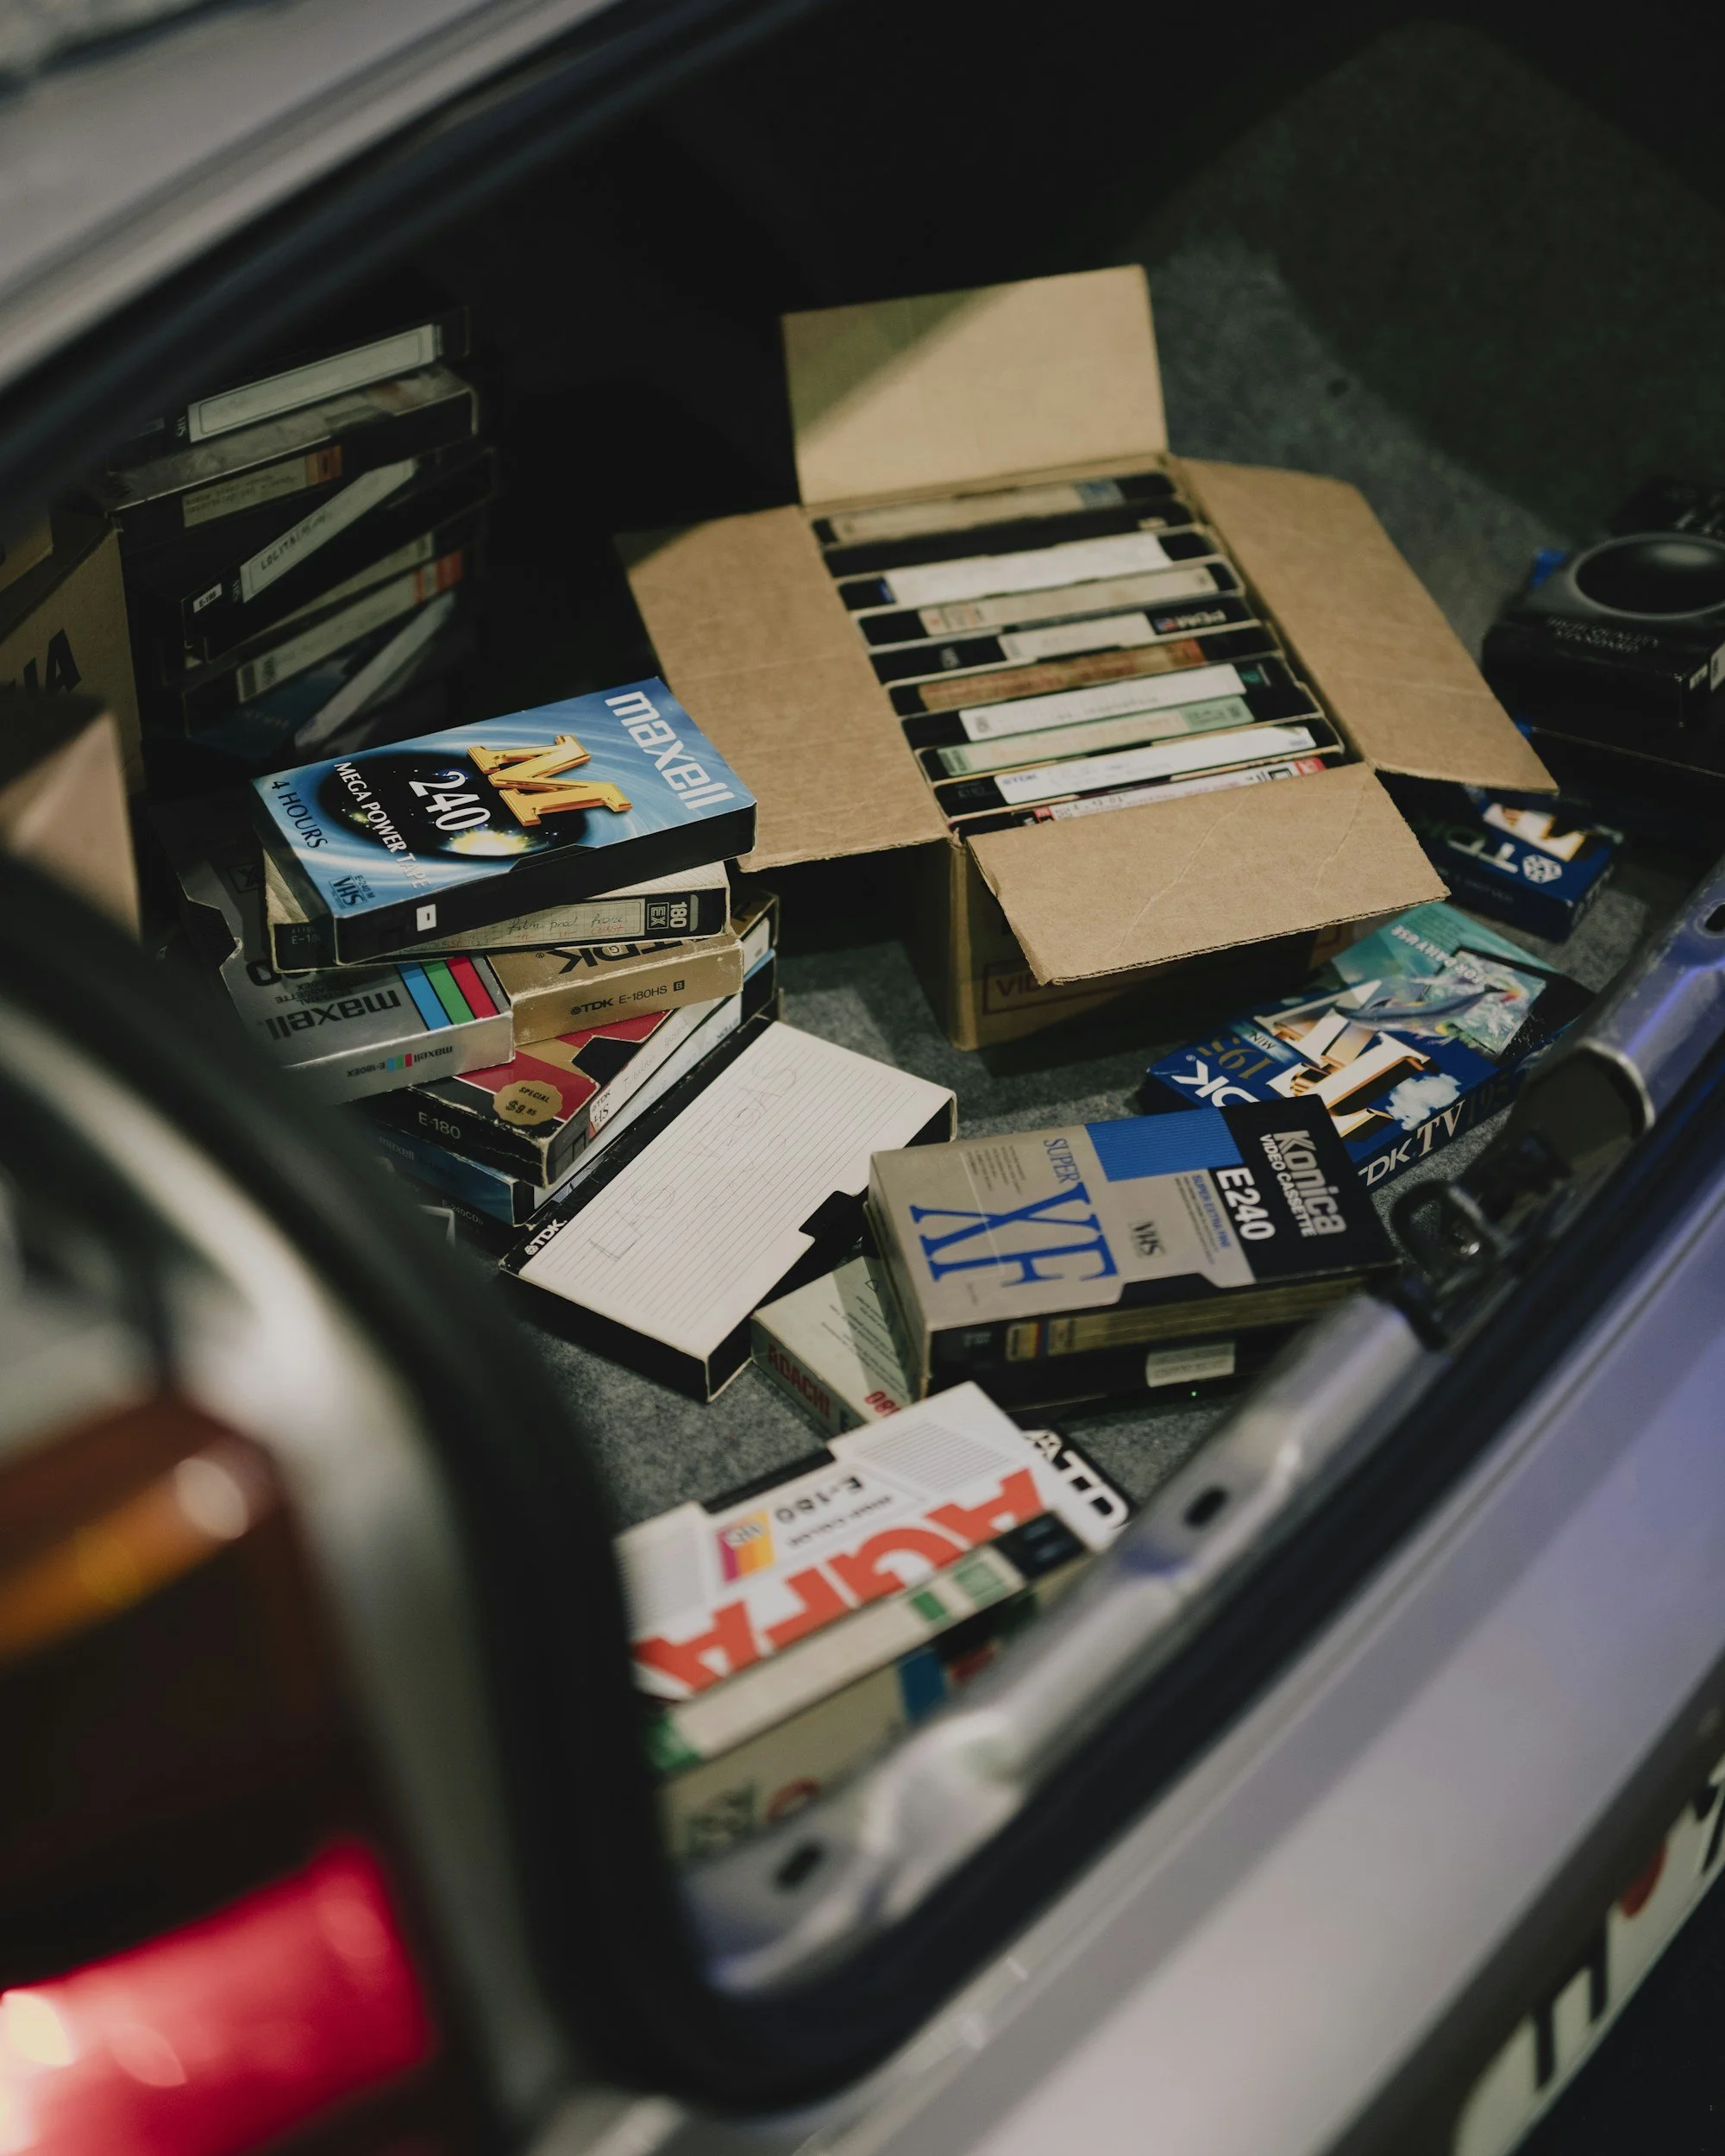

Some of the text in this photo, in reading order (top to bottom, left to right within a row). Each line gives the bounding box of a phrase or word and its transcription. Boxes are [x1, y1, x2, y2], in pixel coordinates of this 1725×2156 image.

[605, 690, 736, 810] maxell
[271, 780, 329, 850] 4 HOURS
[409, 770, 492, 831] 240
[334, 761, 431, 890] MEGA POWER TAPE
[1446, 824, 1519, 874] TD
[333, 877, 365, 905] VHS
[669, 901, 687, 928] 180
[650, 905, 666, 928] EX
[265, 989, 402, 1040] maxell
[581, 981, 684, 1012] TDK E-180HS B
[347, 1045, 454, 1078] maxell E-180EX
[1250, 1031, 1277, 1050] MIN
[518, 1087, 550, 1104] SPECIAL
[1170, 1059, 1261, 1108] DK
[379, 1137, 416, 1162] maxell
[417, 1111, 461, 1139] E-180
[1414, 1098, 1465, 1156] TV
[1043, 1138, 1082, 1185] SUPER
[1258, 1133, 1316, 1238] VIDEO CASSETTE
[1273, 1130, 1348, 1235] Konica
[1216, 1168, 1276, 1242] E240
[530, 1218, 568, 1246] TDK
[909, 1182, 1119, 1288] XF
[1131, 1219, 1165, 1257] VHS
[775, 1474, 864, 1524] E-180
[634, 1467, 1044, 1695] AGFA
